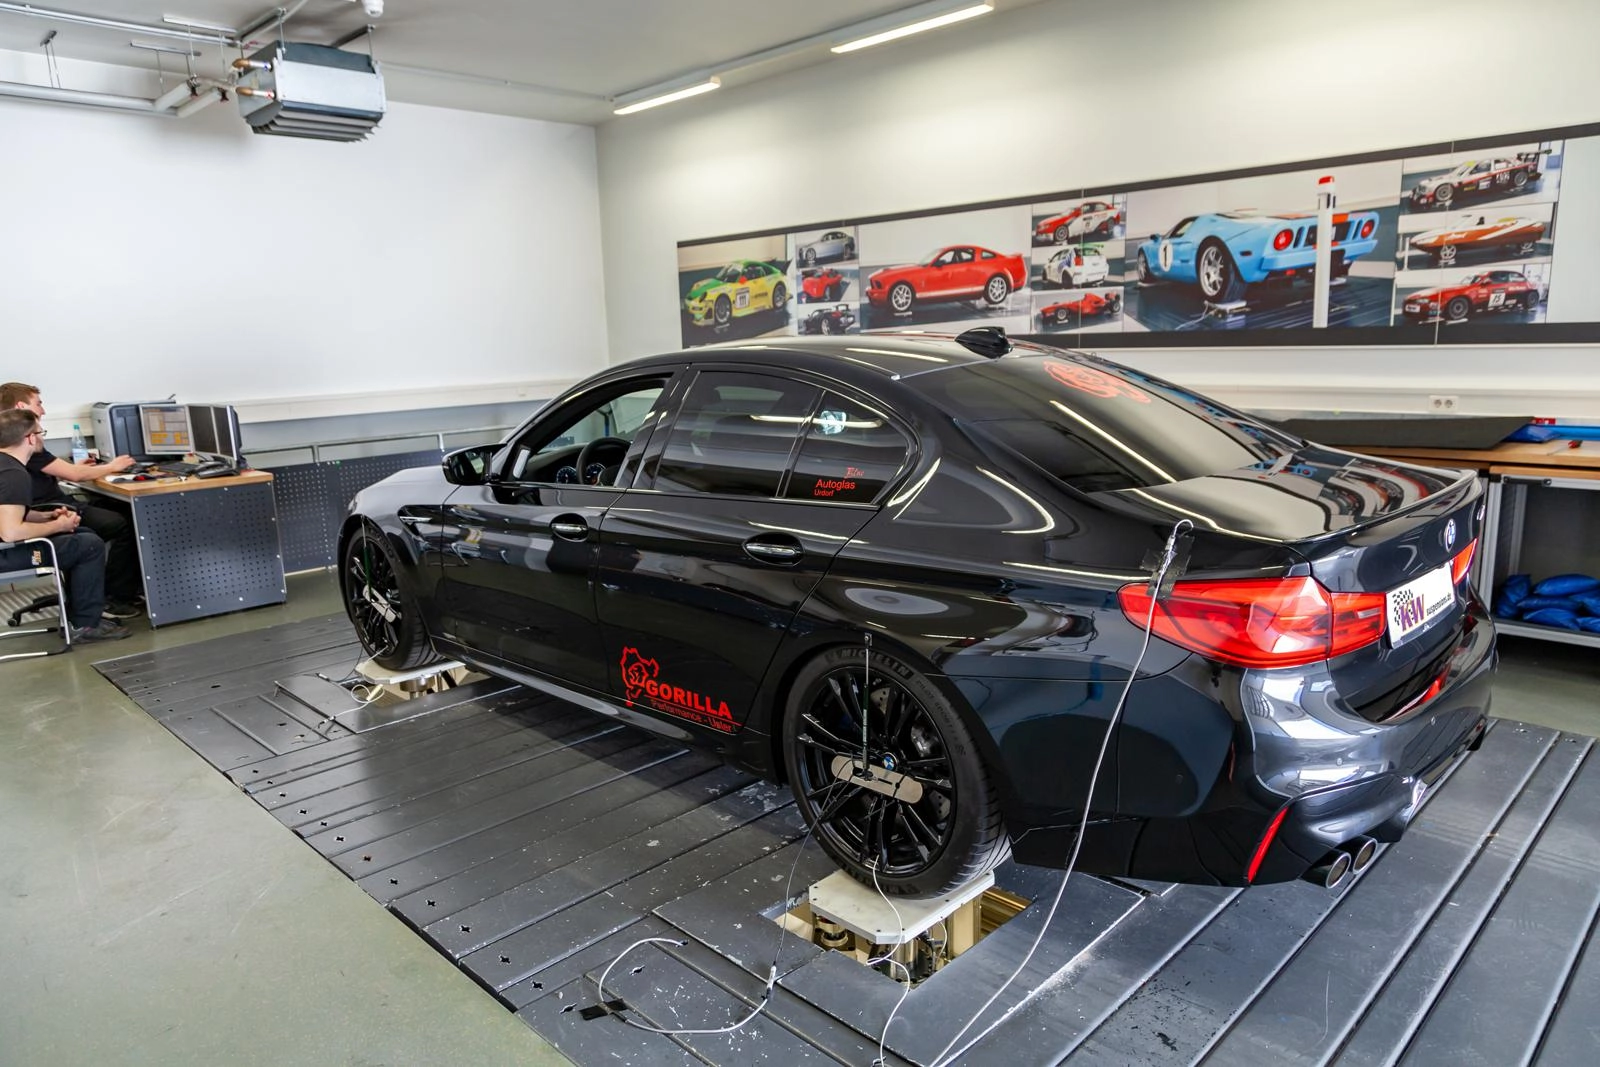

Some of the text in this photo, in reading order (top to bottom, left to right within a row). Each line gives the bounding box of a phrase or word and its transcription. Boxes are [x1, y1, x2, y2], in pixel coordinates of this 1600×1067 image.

[1162, 245, 1169, 268] 1
[815, 479, 856, 491] Autoglas
[1400, 593, 1425, 632] KW
[645, 680, 733, 720] GORILLA
